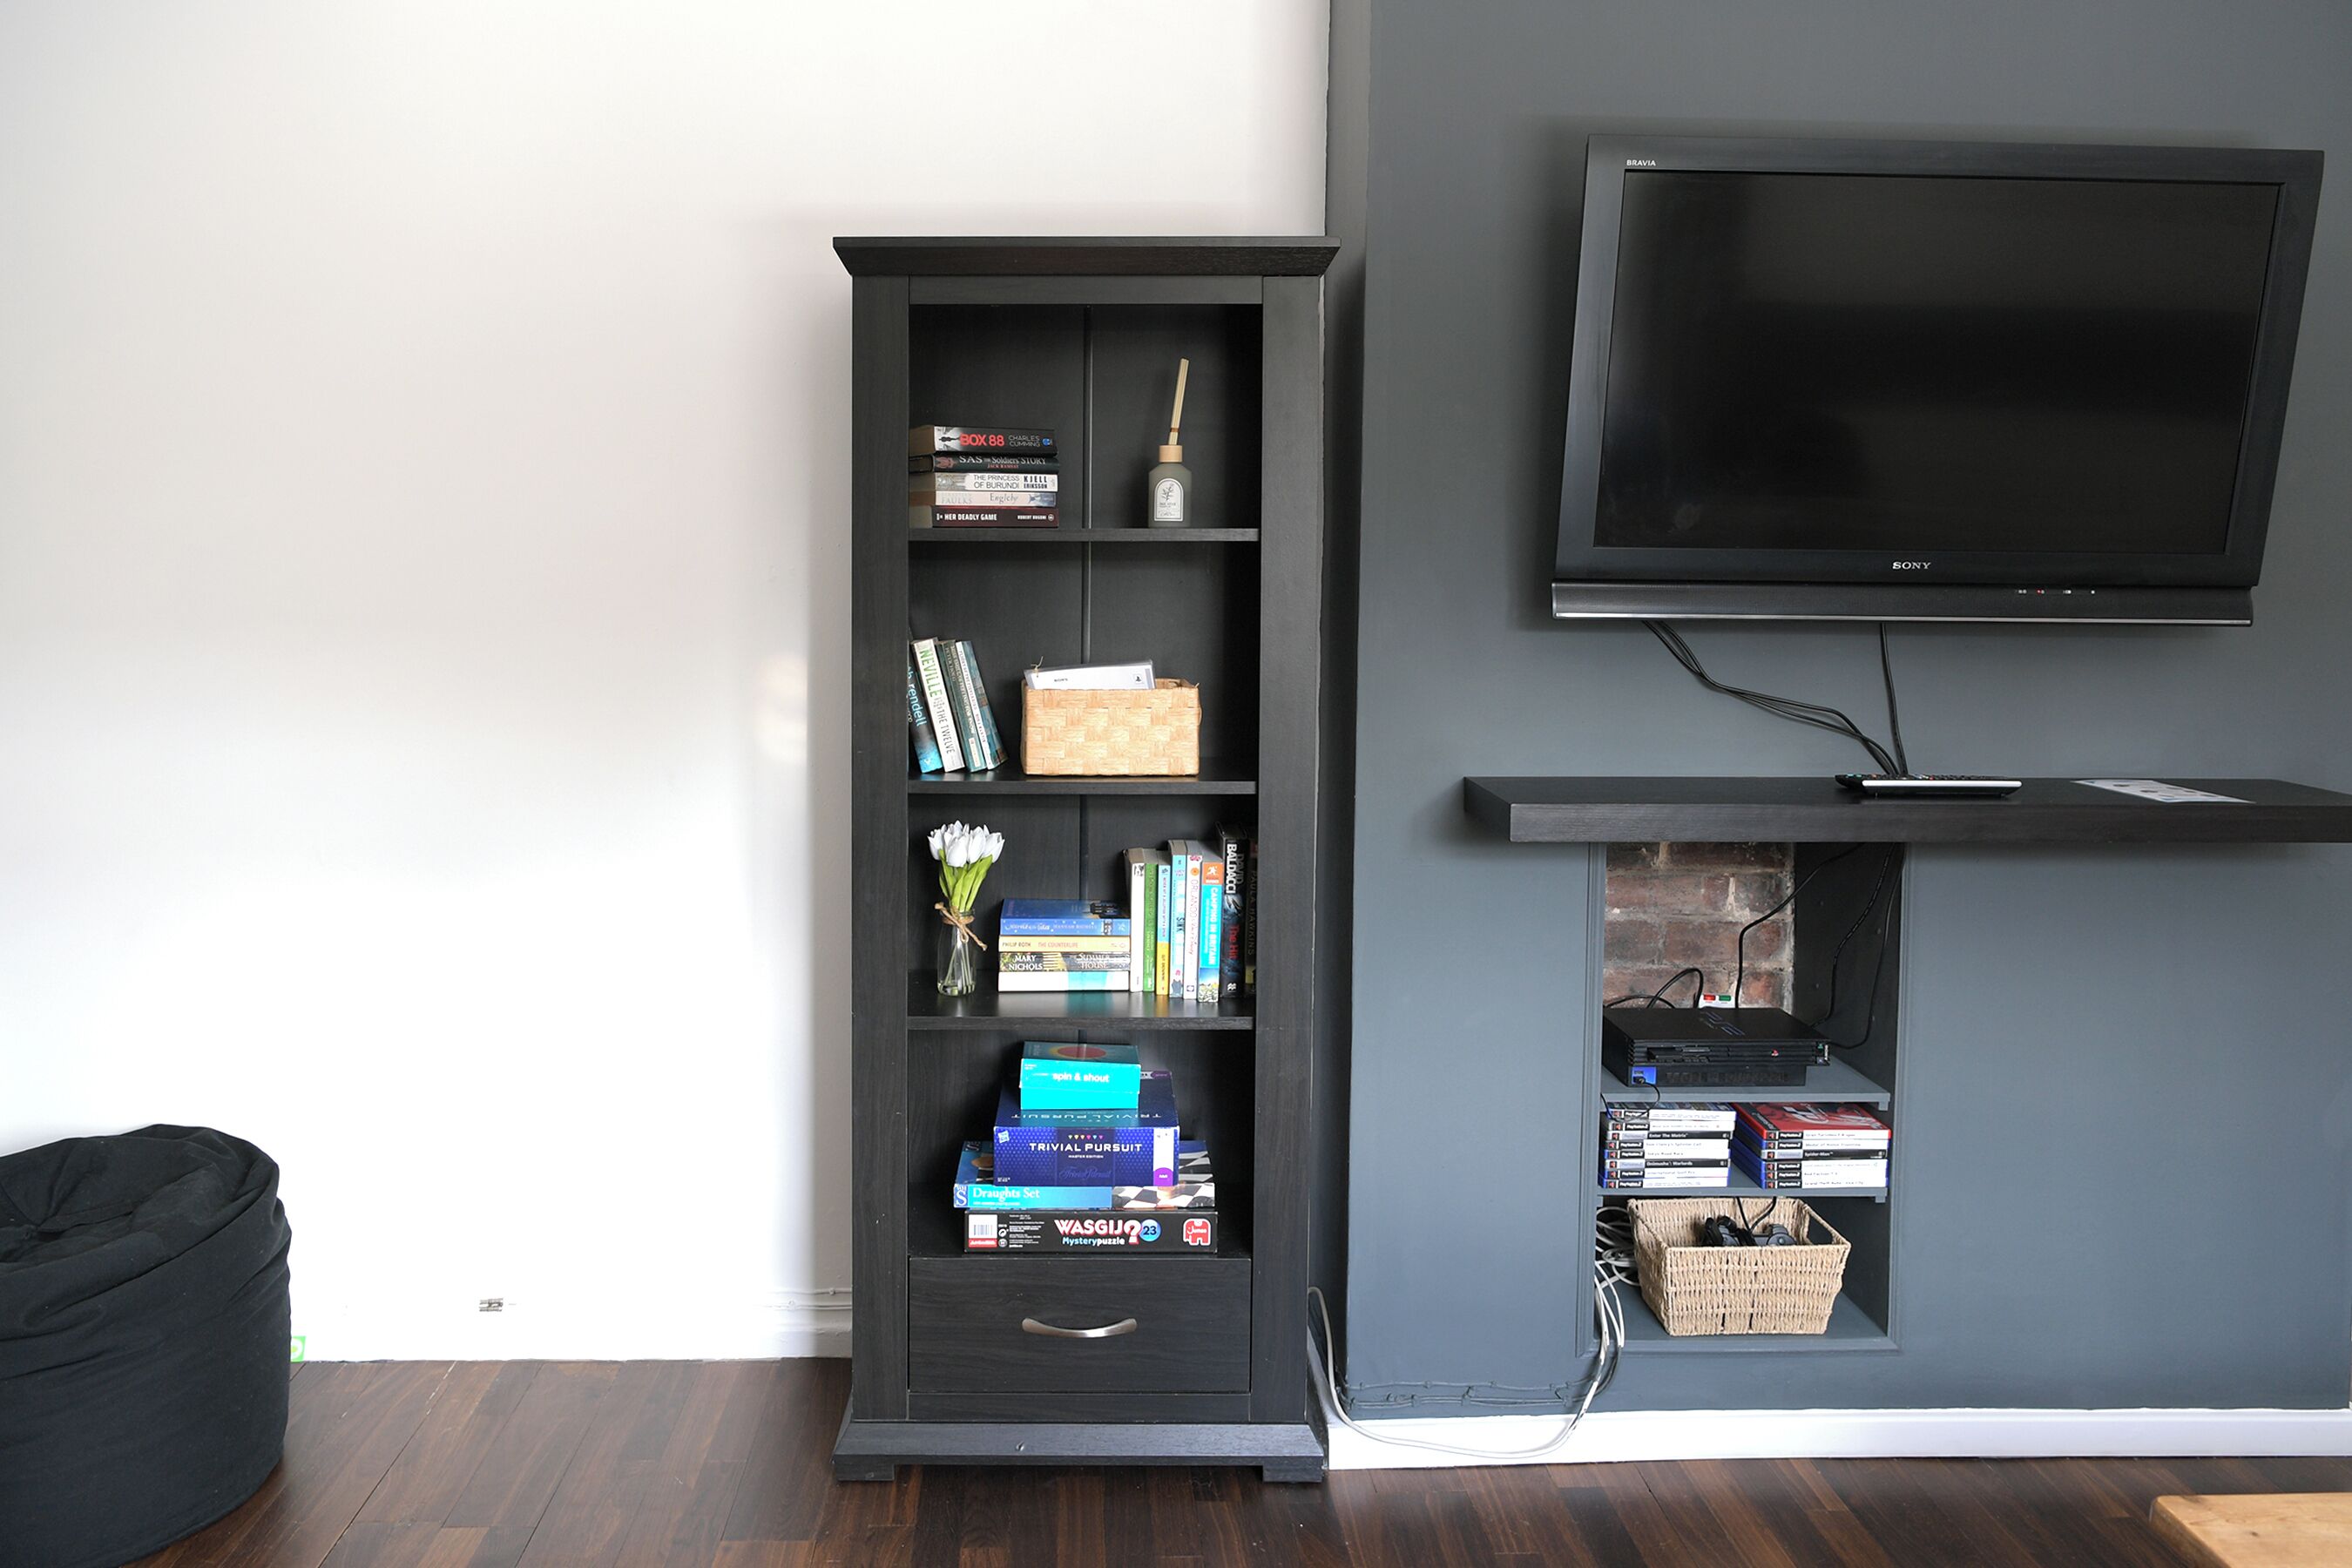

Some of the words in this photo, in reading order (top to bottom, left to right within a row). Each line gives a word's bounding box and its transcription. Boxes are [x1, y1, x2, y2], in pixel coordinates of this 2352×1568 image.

[959, 434, 987, 447] BOX
[989, 435, 1005, 447] 88
[1892, 561, 1932, 571] SONY
[919, 648, 943, 698] NEVILLE
[909, 684, 928, 727] rendell
[936, 707, 948, 724] THE
[940, 724, 956, 755] TWELVE
[1226, 843, 1237, 894] BALDACCI
[1189, 879, 1200, 918] ORLANDO
[1209, 887, 1219, 923] CAMPING
[1209, 923, 1218, 933] IN
[1229, 925, 1240, 943] The
[1247, 909, 1257, 956] HAWKINS
[1208, 933, 1218, 965] BRITAIN
[1228, 944, 1240, 959] Hit
[1009, 963, 1044, 971] NICHOLS
[1052, 1072, 1072, 1082] spin
[1083, 1073, 1110, 1083] shout
[1030, 1143, 1082, 1152] TRIVIAL
[1085, 1143, 1142, 1152] PURSUIT
[973, 1186, 1021, 1203] Draughts
[1023, 1187, 1040, 1199] Set
[1143, 1226, 1157, 1235] 23
